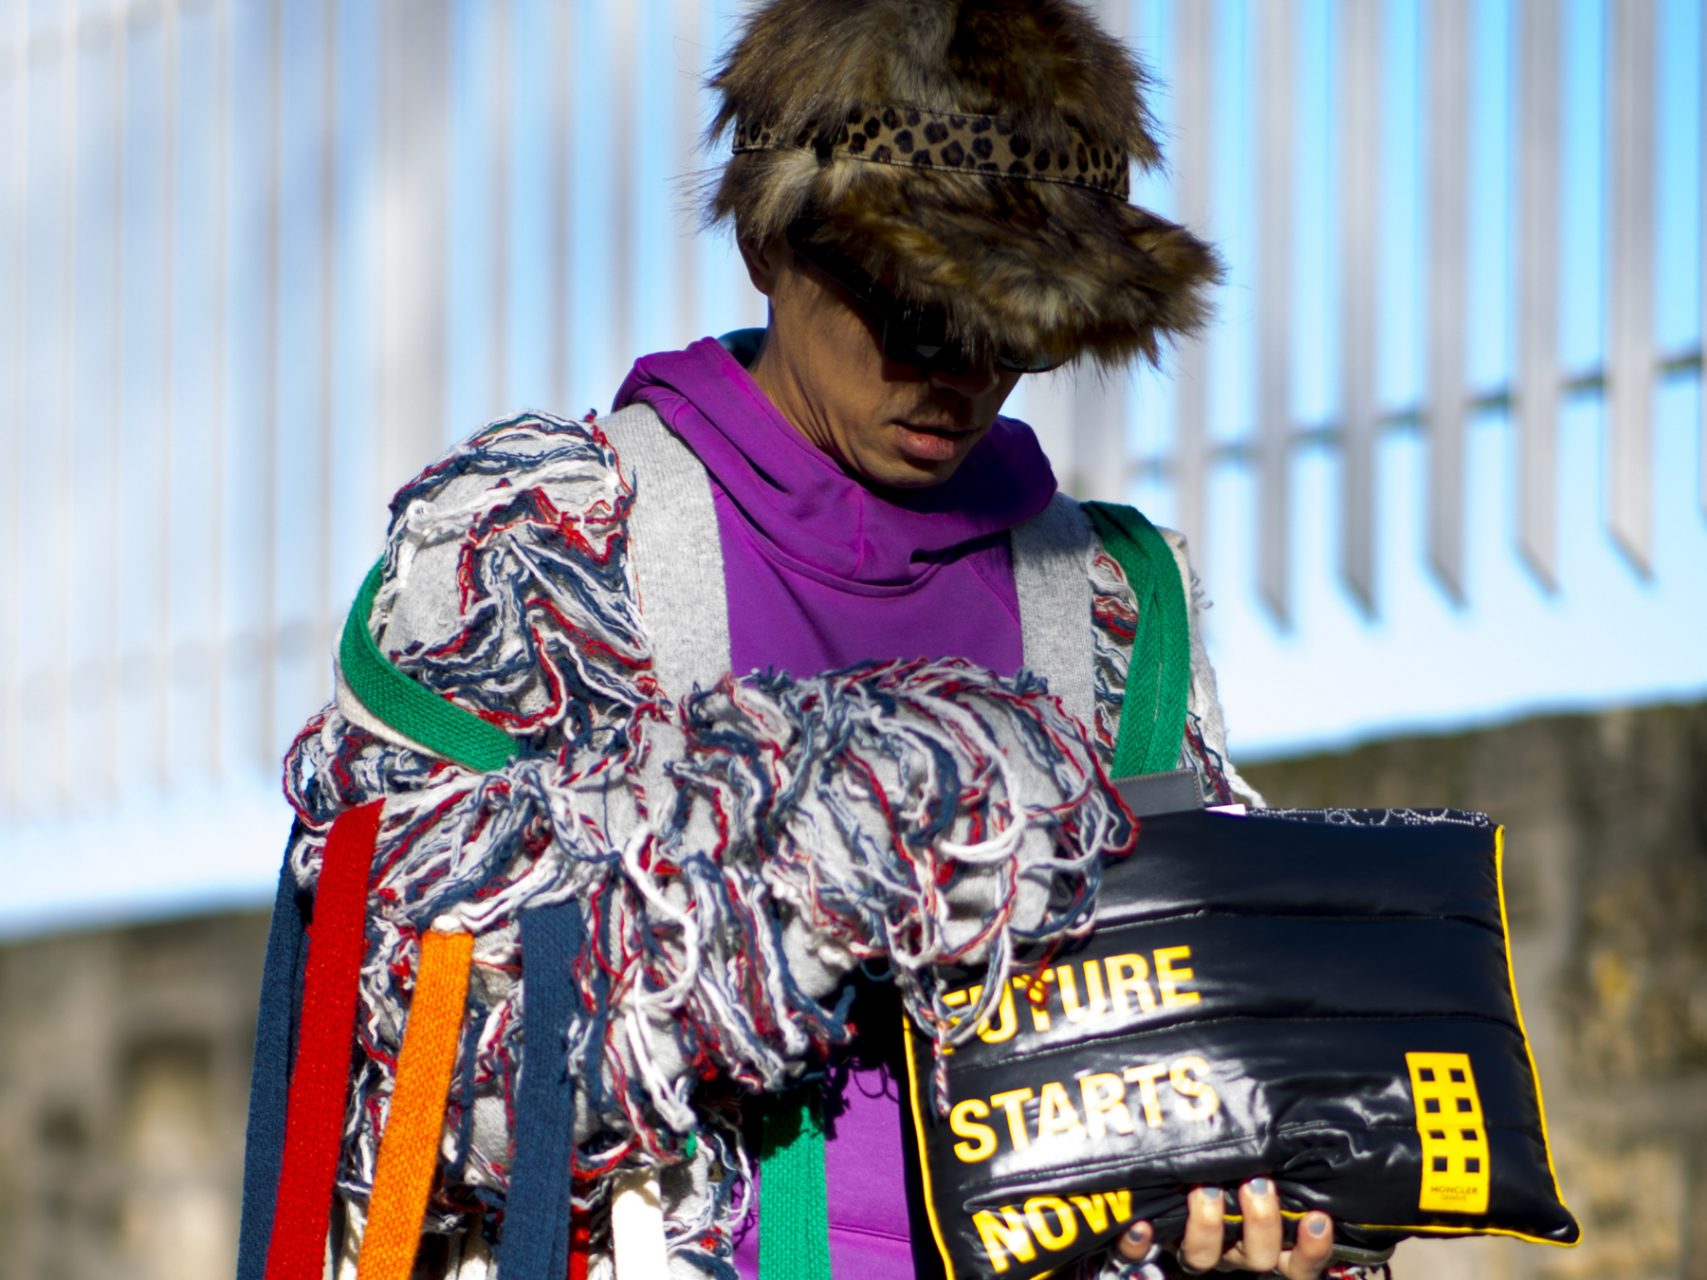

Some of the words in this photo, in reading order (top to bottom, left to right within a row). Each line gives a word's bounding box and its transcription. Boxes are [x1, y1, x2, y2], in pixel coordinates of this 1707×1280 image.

[950, 1056, 1220, 1163] STARTS
[972, 1190, 1133, 1273] NOW
[1430, 1185, 1478, 1195] MONCLER
